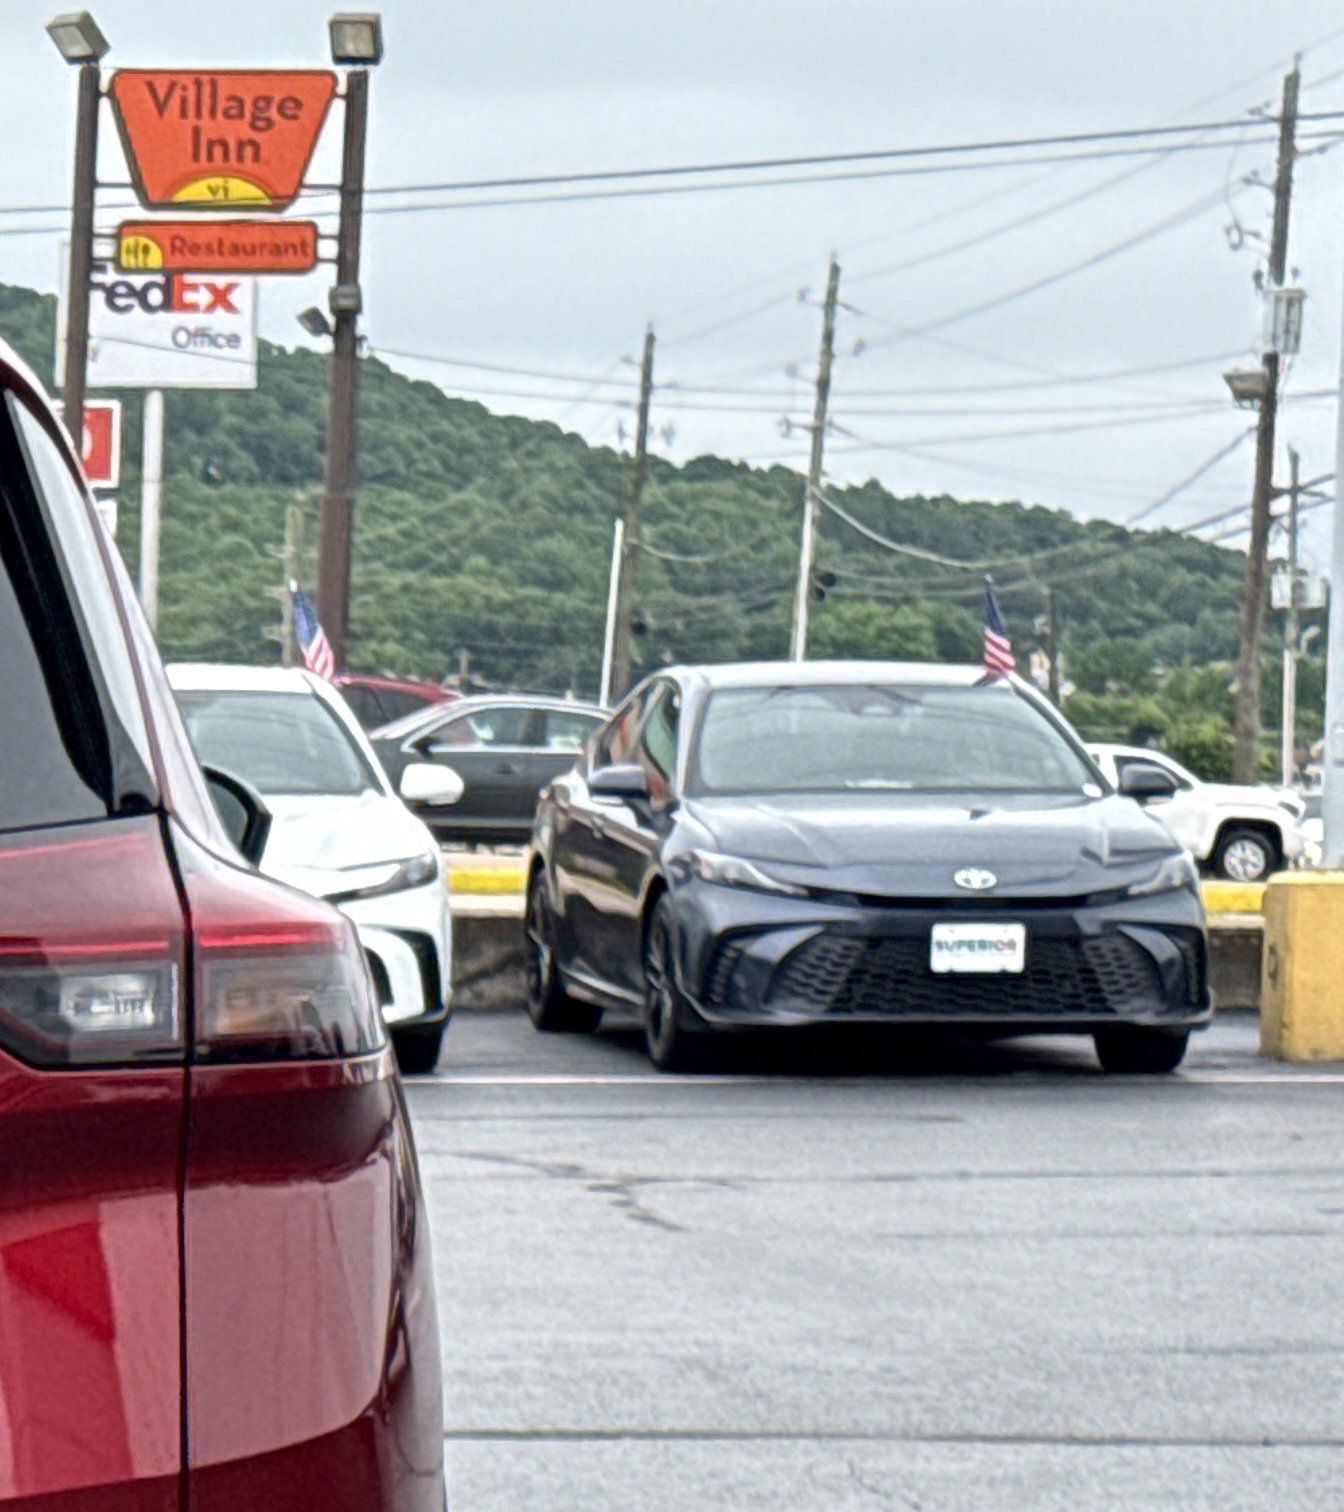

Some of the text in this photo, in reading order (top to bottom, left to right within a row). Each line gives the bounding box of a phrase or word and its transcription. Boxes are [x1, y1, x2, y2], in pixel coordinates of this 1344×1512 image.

[146, 76, 303, 132] Village
[191, 124, 262, 164] Inn
[169, 235, 310, 259] Restaurant
[172, 325, 242, 350] Office
[935, 939, 1017, 952] SUPERIOR
